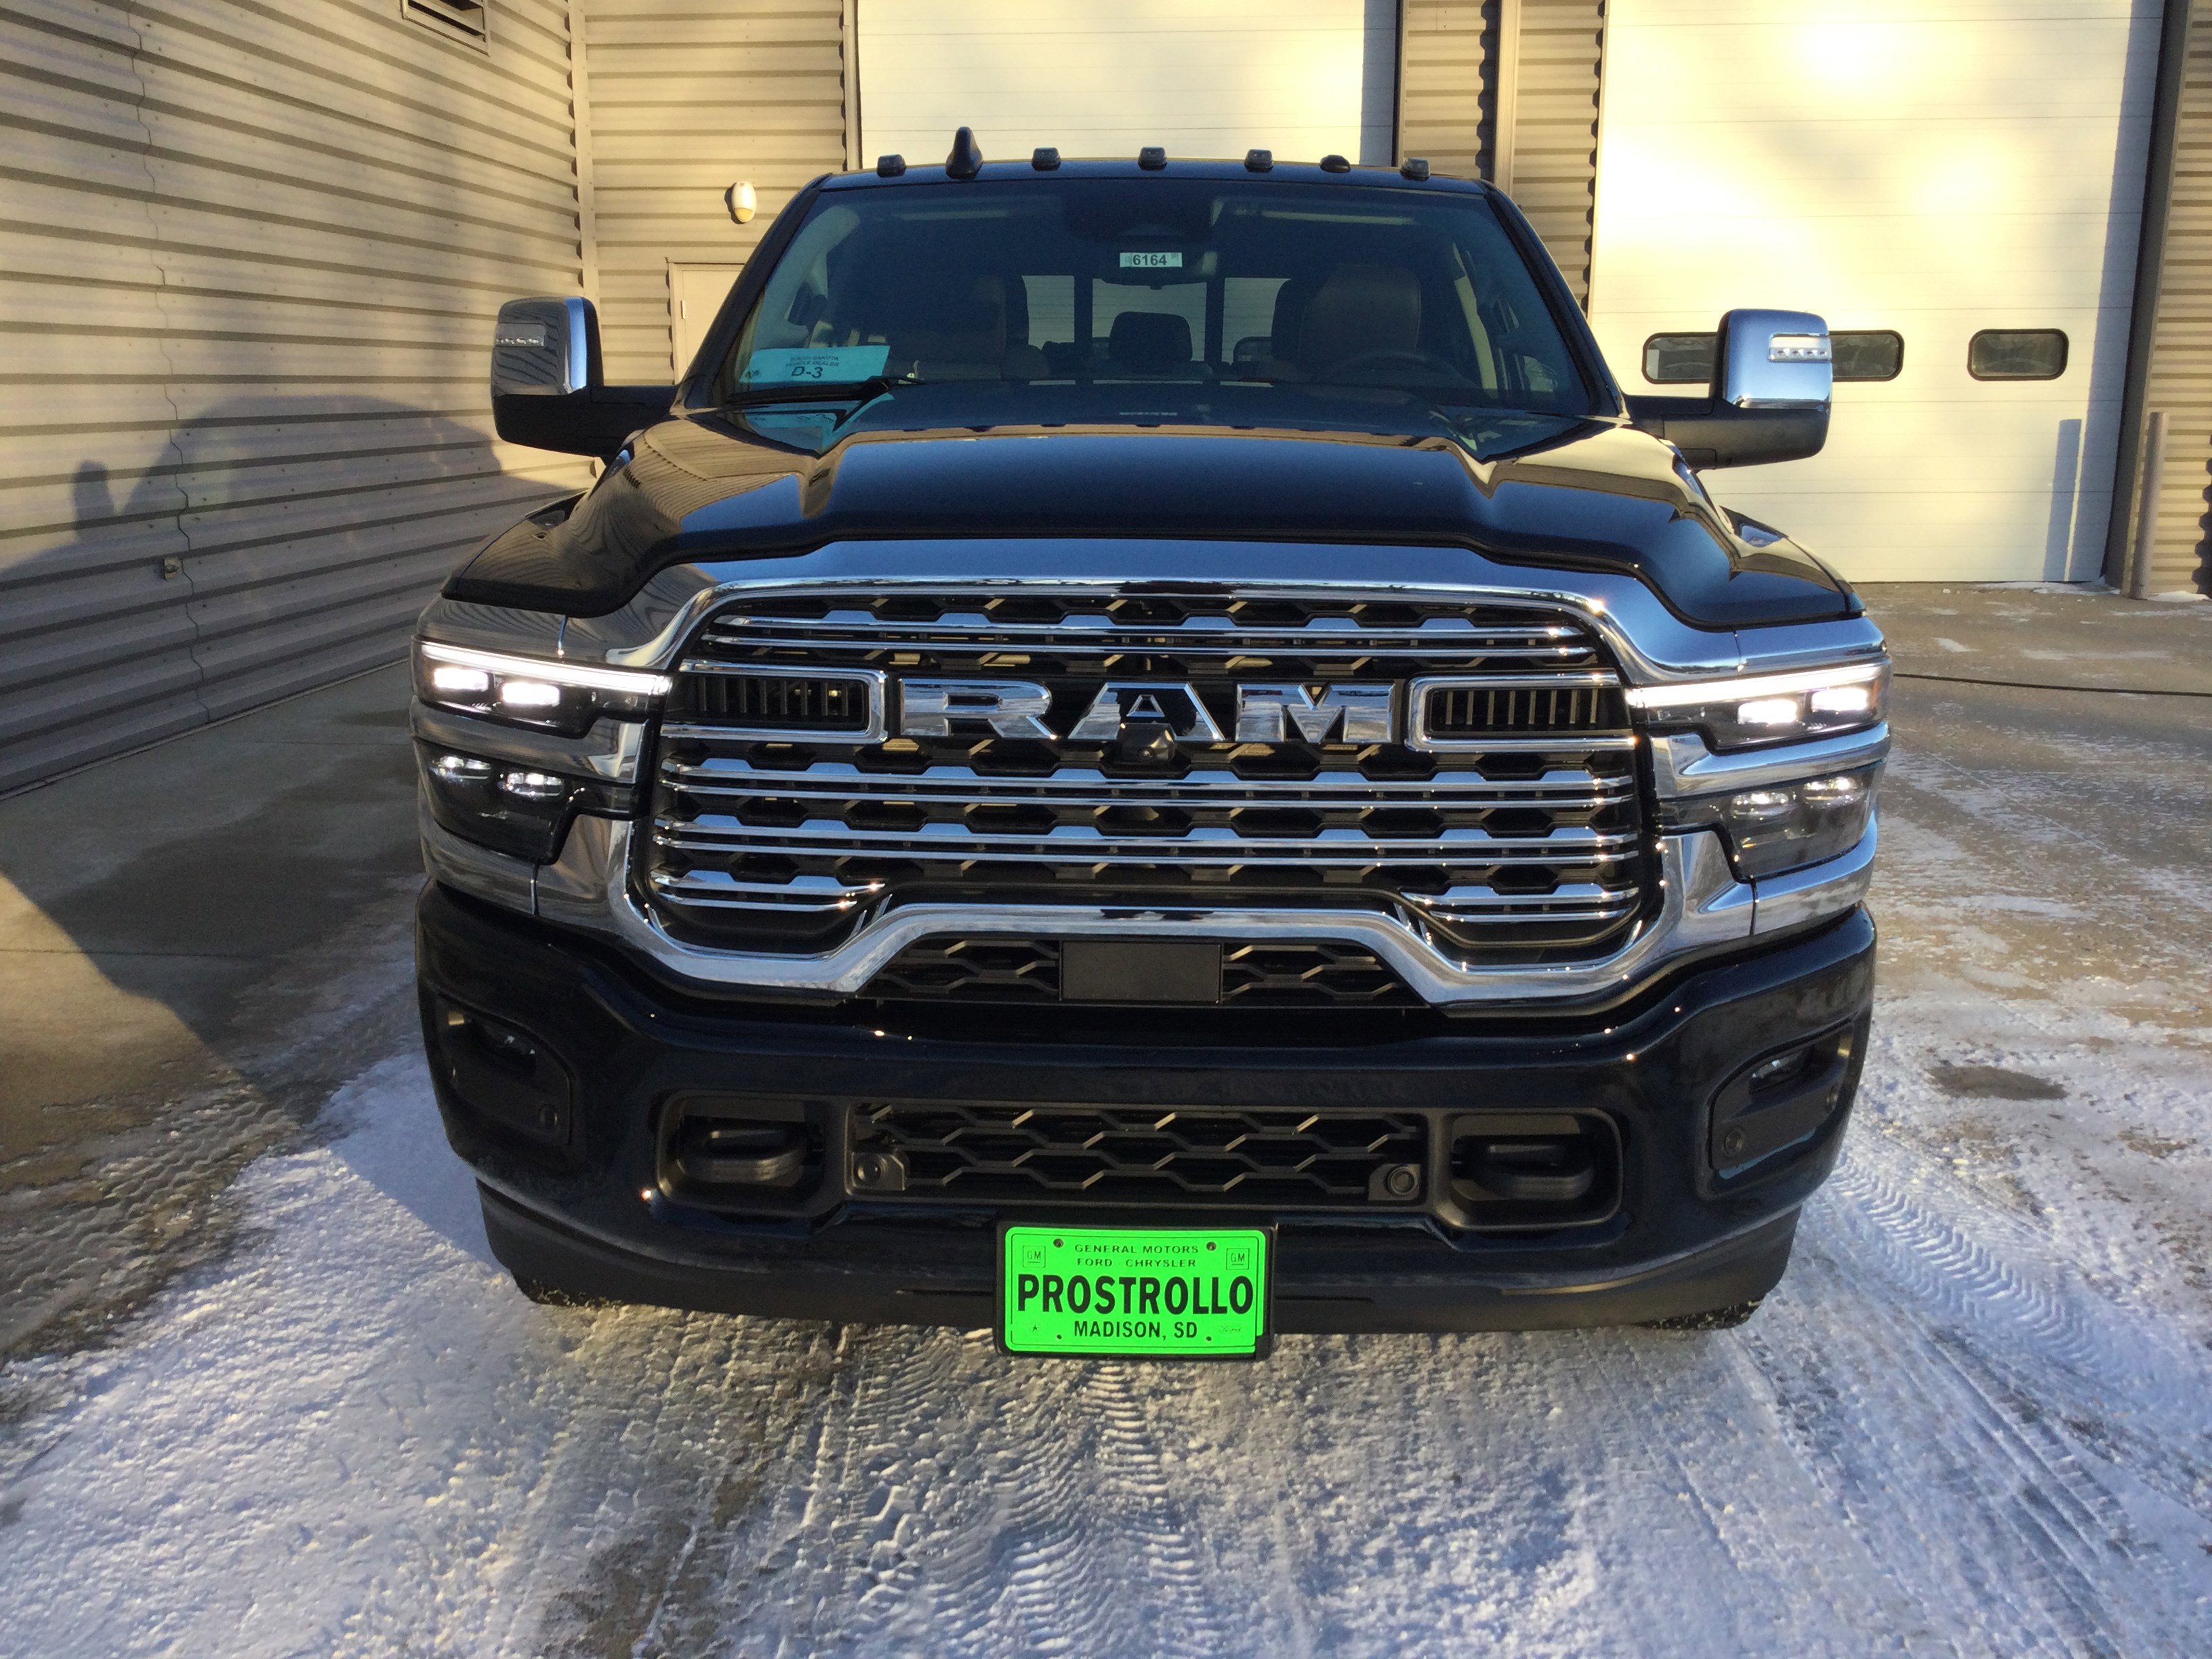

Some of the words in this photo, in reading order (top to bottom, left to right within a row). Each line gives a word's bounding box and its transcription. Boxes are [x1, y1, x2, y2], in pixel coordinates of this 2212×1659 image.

[1132, 254, 1167, 266] 6164
[792, 367, 823, 378] D-3
[899, 678, 1396, 743] RAM
[1074, 1244, 1137, 1254] GENERAL
[1143, 1246, 1199, 1254] MOTORS
[1027, 1251, 1042, 1261] GM
[1230, 1252, 1245, 1263] GM
[1078, 1258, 1113, 1267] FORD
[1126, 1258, 1196, 1267] CHRYSLER
[1018, 1274, 1254, 1315] PROSTROLLO
[1074, 1321, 1166, 1340] MADISON,
[1174, 1322, 1197, 1339] SD
